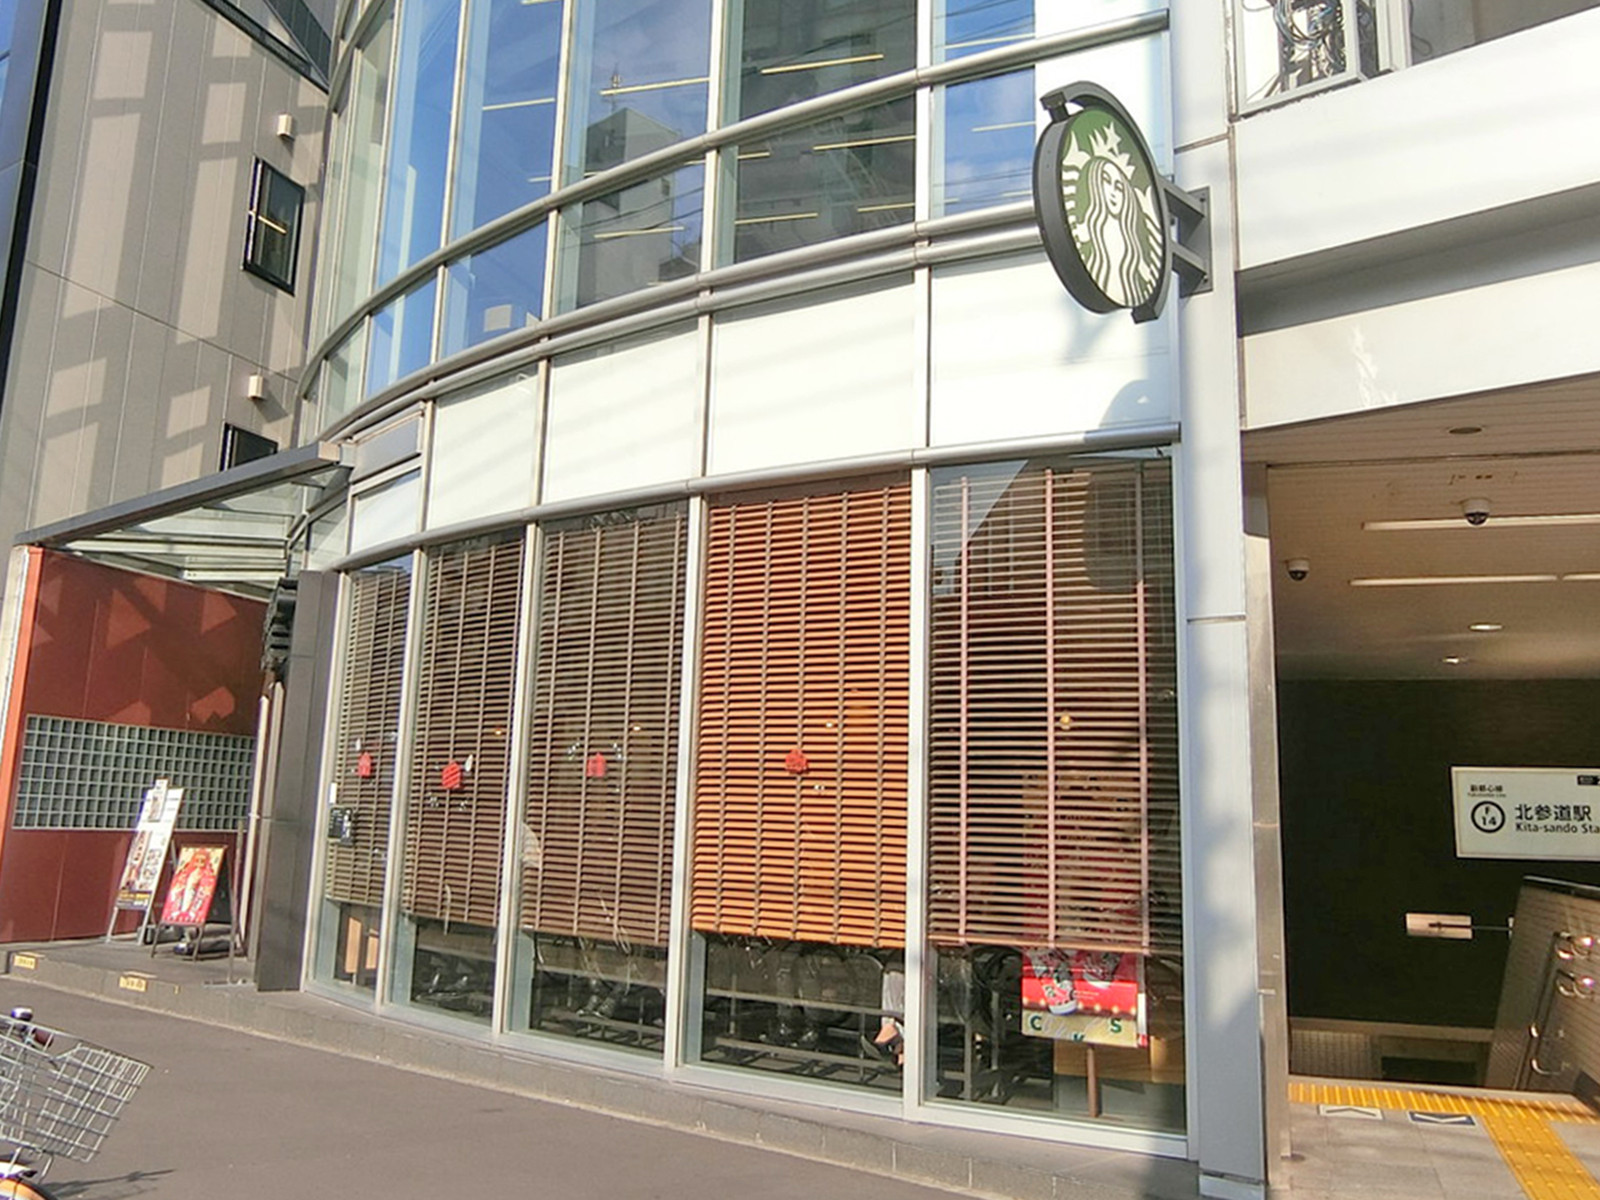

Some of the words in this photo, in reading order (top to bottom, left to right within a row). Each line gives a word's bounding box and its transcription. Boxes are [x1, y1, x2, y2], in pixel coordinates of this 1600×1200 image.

[1485, 807, 1490, 815] F
[1515, 804, 1592, 822] 北参道駅
[1482, 817, 1497, 826] 14
[1516, 823, 1578, 833] Kita-sando
